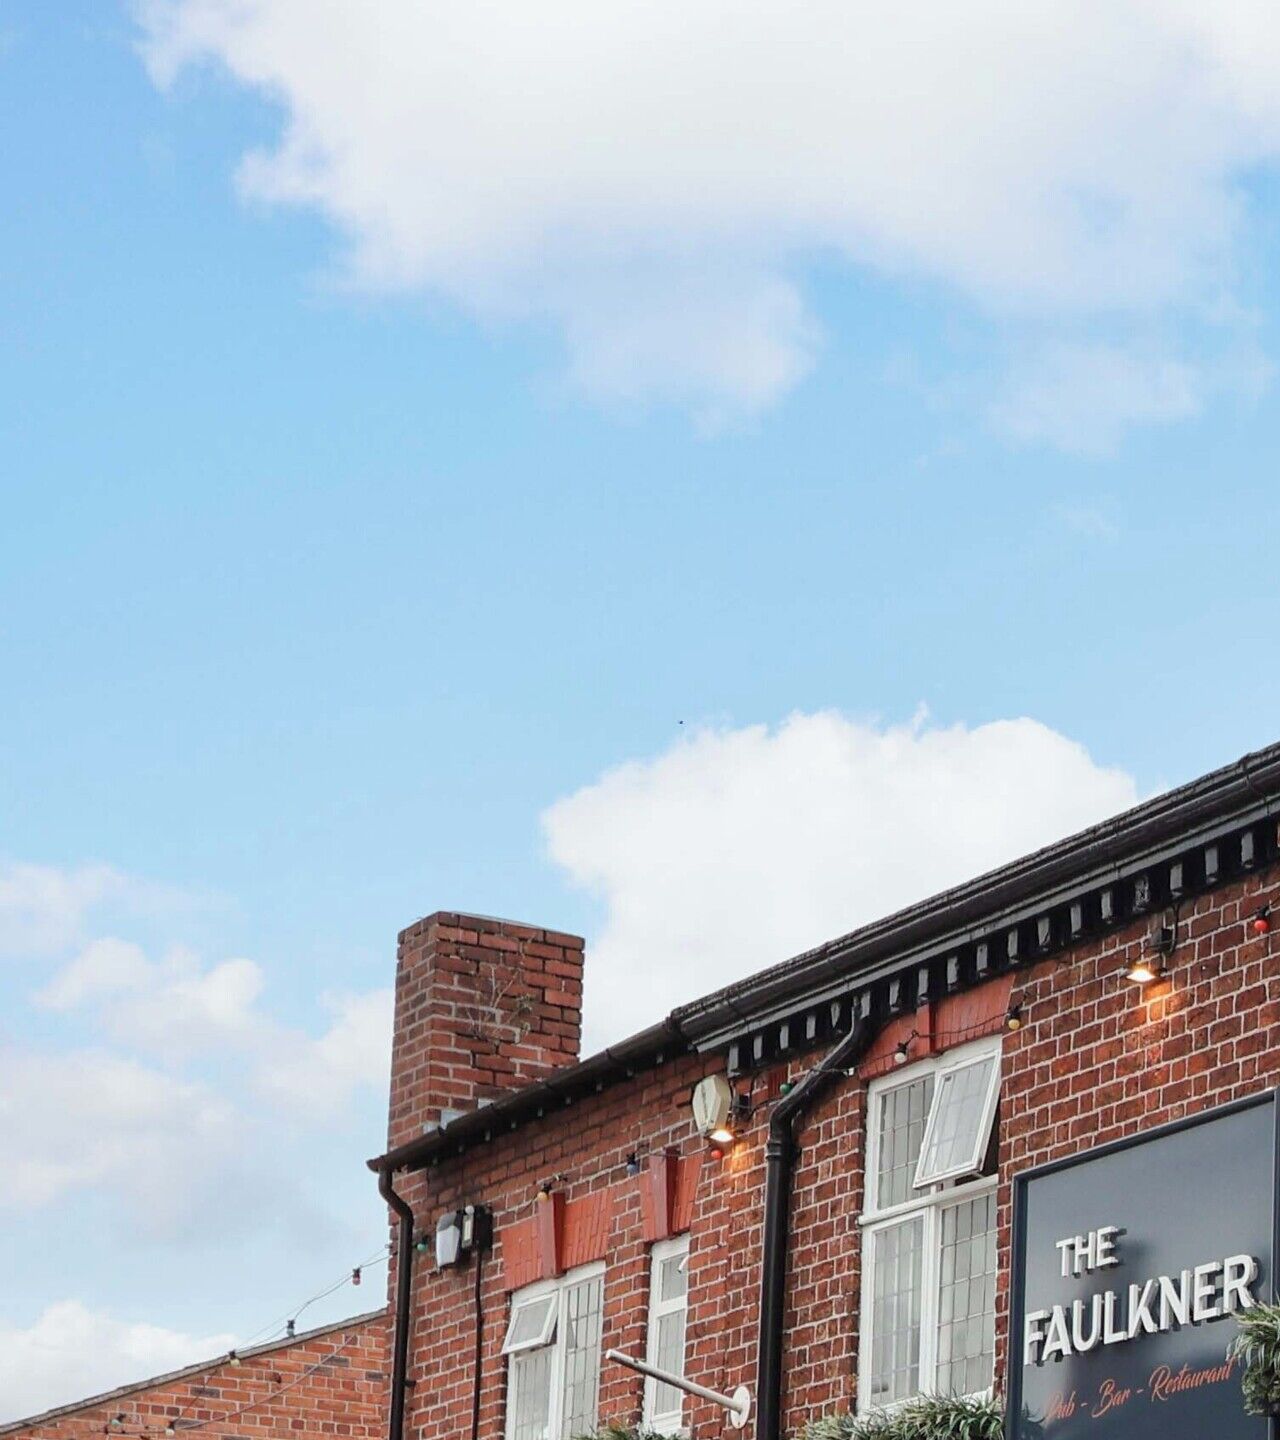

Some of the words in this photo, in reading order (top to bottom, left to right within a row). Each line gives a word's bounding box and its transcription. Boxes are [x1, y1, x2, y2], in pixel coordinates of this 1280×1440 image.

[1056, 1225, 1119, 1278] THE
[1023, 1253, 1258, 1367] FAULKNER
[1092, 1379, 1130, 1418] Bar
[1149, 1356, 1237, 1402] Restaurant
